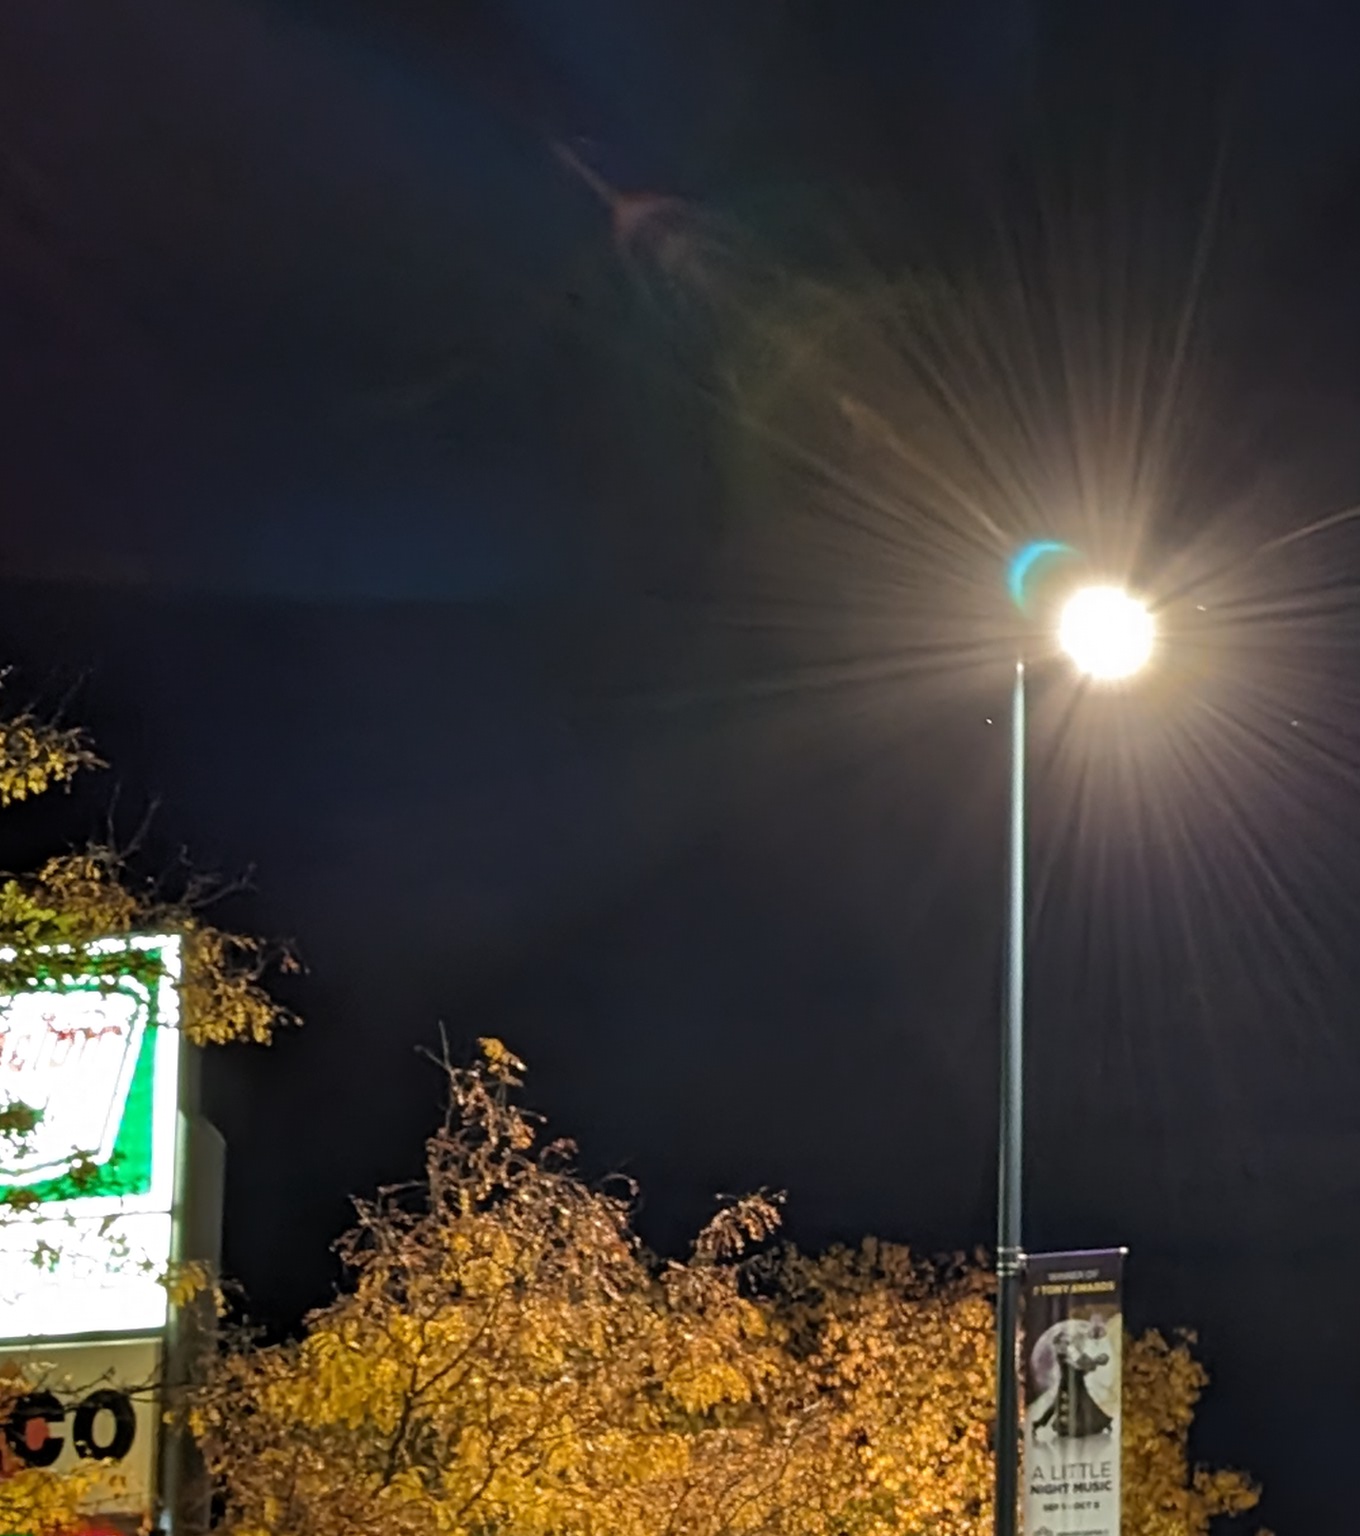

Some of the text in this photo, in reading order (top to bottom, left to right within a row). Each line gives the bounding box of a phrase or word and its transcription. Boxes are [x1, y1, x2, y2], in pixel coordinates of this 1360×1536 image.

[1031, 1461, 1111, 1480] A LITTLE
[1030, 1480, 1112, 1494] NIGHT MUSIC
